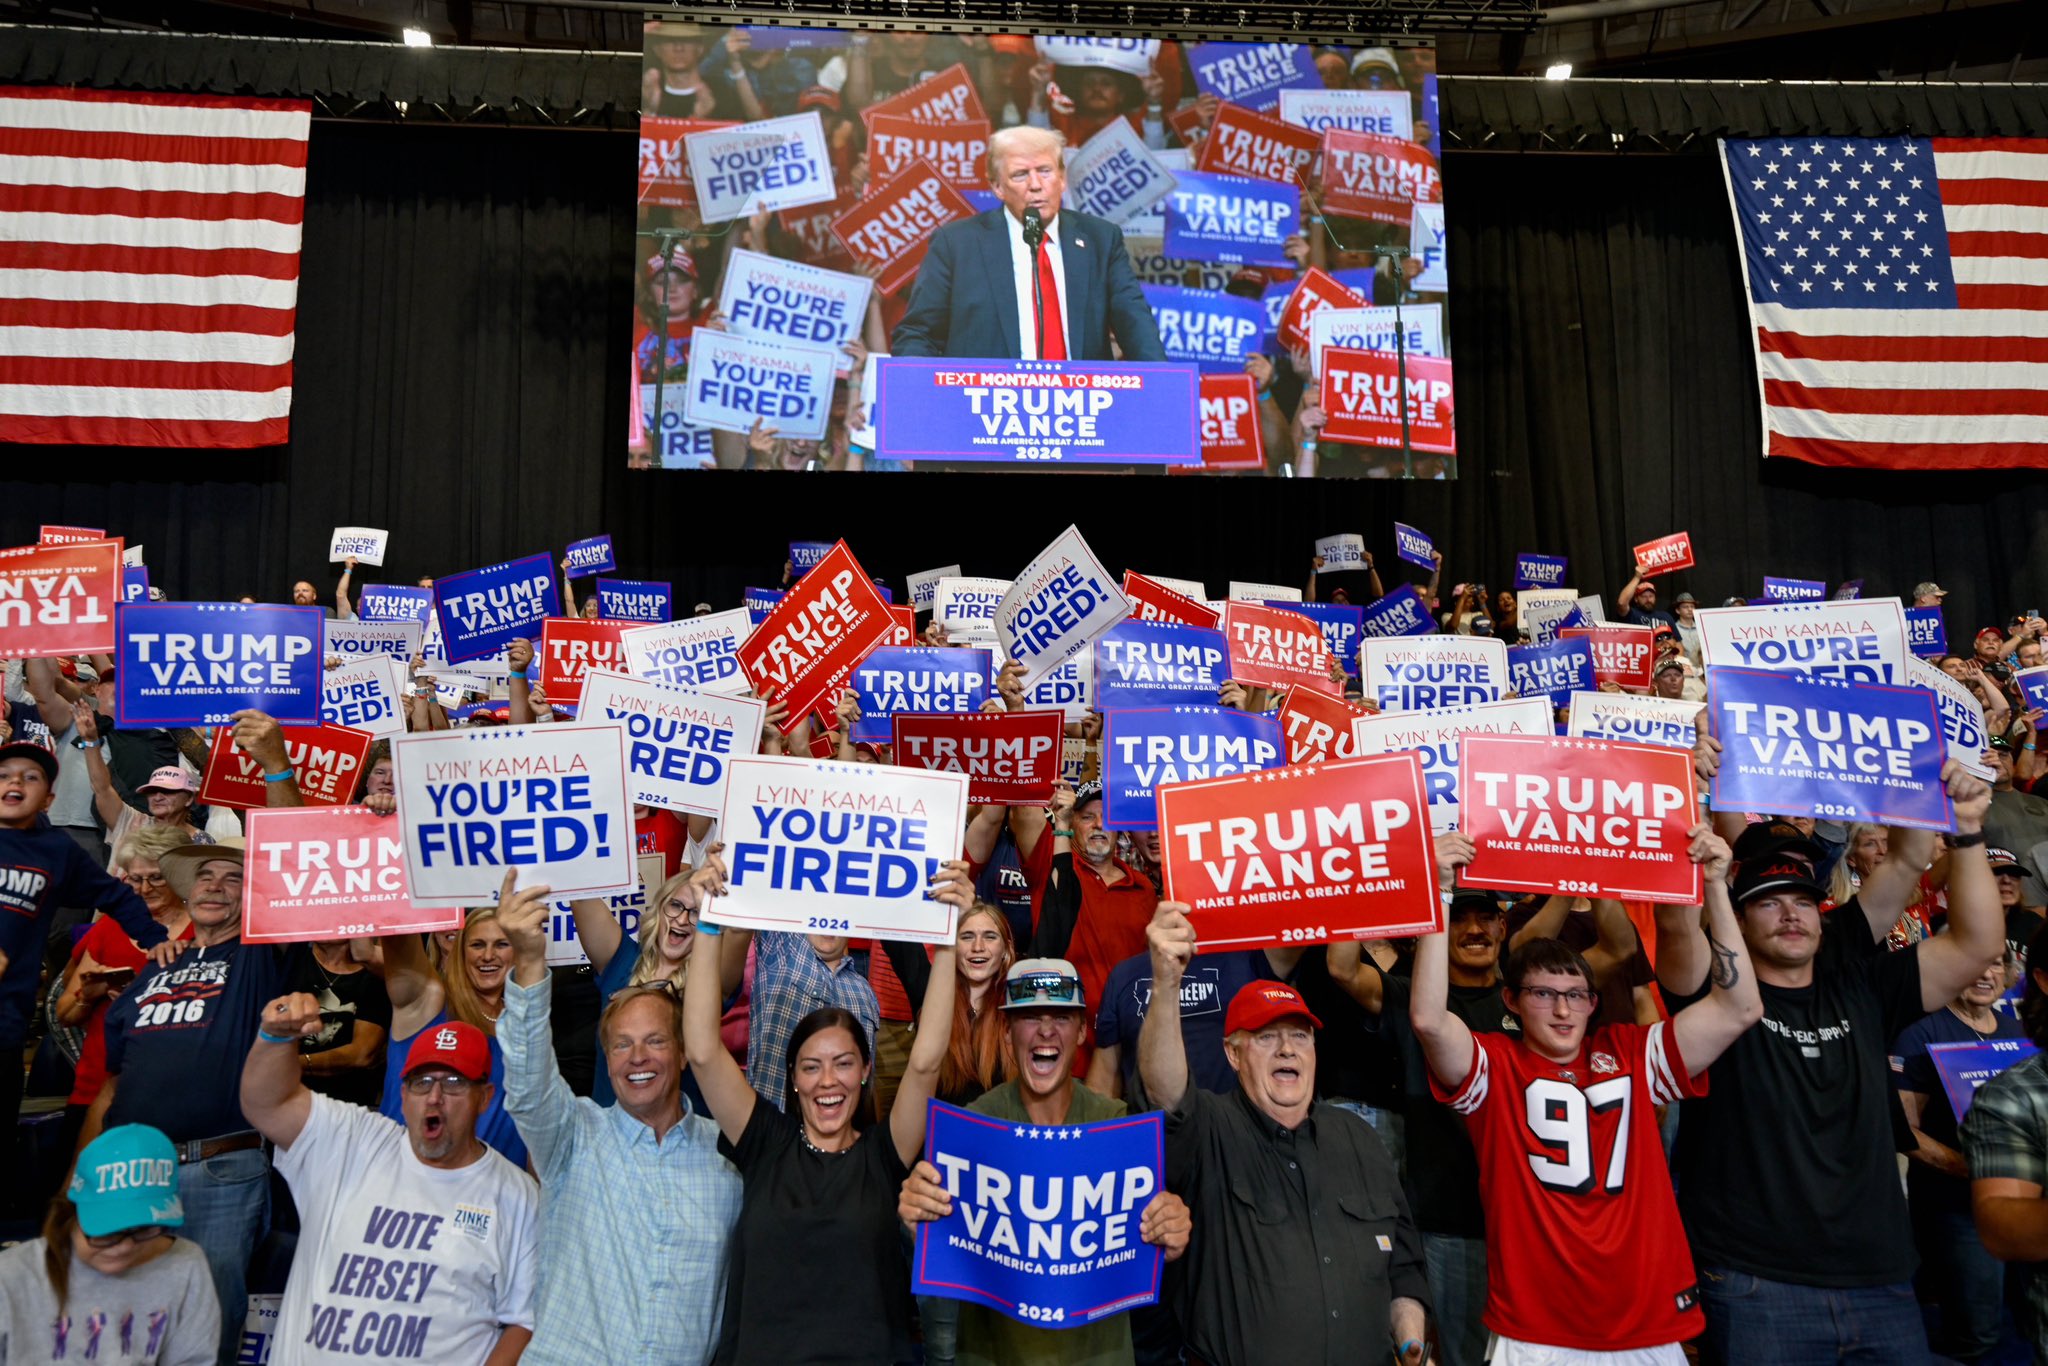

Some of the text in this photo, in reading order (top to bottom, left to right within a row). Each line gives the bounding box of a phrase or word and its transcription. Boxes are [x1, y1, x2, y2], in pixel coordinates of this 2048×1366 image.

[1199, 43, 1299, 85] TRUMP
[711, 142, 806, 174] YOU'RE
[874, 133, 985, 161] TRUMP
[1217, 123, 1311, 168] TRUMP
[1075, 148, 1136, 199] YOU'RE
[1223, 145, 1297, 184] VANCE
[1334, 149, 1440, 186] TRUMP
[707, 160, 818, 200] FIRED!
[1342, 172, 1431, 201] VANCE
[848, 178, 940, 253] TRUMP
[1173, 192, 1291, 221] TRUMP
[870, 200, 948, 260] VANCE
[1186, 214, 1279, 237] VANCE
[746, 281, 846, 319] YOU'RE
[729, 299, 849, 345] FIRED!
[711, 359, 811, 393] YOU'RE
[936, 372, 1141, 388] TEXT MONTANA TO 88022
[1329, 369, 1451, 402] TRUMP
[699, 379, 818, 420] FIRED!
[964, 388, 1113, 416] TRUMP
[981, 414, 1096, 437] VANCE
[1015, 447, 1062, 459] 2024
[335, 544, 379, 557] FIRED!
[339, 537, 377, 547] YOU'RE
[567, 543, 610, 561] TRUMP
[1398, 532, 1433, 550] TRUMP
[1639, 540, 1687, 561] TRUMP
[1519, 561, 1564, 574] TRUMP
[1524, 570, 1558, 580] VANCE
[365, 595, 427, 609] TRUMP
[443, 576, 550, 617] TRUMP
[601, 591, 667, 606] TRUMP
[1003, 556, 1072, 625] LYIN' KAMALA
[1006, 564, 1084, 637] YOU'RE
[0, 596, 108, 627] TRU
[369, 606, 418, 618] VANCE
[461, 597, 544, 632] VANCE
[607, 603, 660, 617] VANCE
[751, 569, 854, 679] TRUMP
[1009, 578, 1109, 666] FIRED!
[331, 631, 407, 640] LYIN' KAMALA
[458, 623, 510, 641] MAKE AMERICA
[645, 626, 734, 651] LYIN' KAMALA
[769, 600, 860, 685] VANCE
[1233, 622, 1328, 654] TRUMP
[1730, 620, 1876, 640] LYIN' KAMALA
[129, 633, 312, 663] TRUMP
[331, 639, 406, 653] YOU'RE
[645, 636, 736, 668] YOU'RE
[775, 610, 870, 701] MAKE AMERICA GREAT AGAIN!
[1065, 639, 1087, 657] 2024
[1102, 640, 1223, 668] TRUMP
[1243, 643, 1325, 671] VANCE
[1385, 651, 1488, 664] LYIN' KAMALA
[1730, 634, 1880, 666] YOU'RE
[150, 662, 292, 686] VANCE
[825, 665, 849, 688] 2024
[1117, 663, 1213, 685] VANCE
[1236, 657, 1306, 674] MAKE AMERICA GREAT
[1384, 664, 1490, 684] YOU'RE
[141, 687, 171, 696] MAKE
[174, 687, 223, 695] AMERICA
[263, 687, 301, 695] AGAIN!
[859, 669, 984, 694] TRUMP
[1133, 683, 1167, 691] AMERICA
[1509, 672, 1579, 693] VANCE
[1933, 680, 1975, 711] KAMALA
[609, 693, 735, 729] LYIN' KAMALA
[873, 693, 969, 712] VANCE
[1377, 684, 1500, 711] FIRED!
[1594, 704, 1697, 723] LYIN' KAMALA
[1723, 702, 1931, 751] TRUMP
[605, 707, 734, 754] YOU'RE
[1592, 714, 1697, 743] YOU'RE
[903, 735, 1052, 760] TRUMP
[1115, 735, 1277, 766] TRUMP
[1749, 735, 1914, 778] VANCE
[426, 753, 588, 782] LYIN' KAMALA
[1739, 765, 1923, 791] MAKE AMERICA GREAT AGAIN!
[426, 775, 592, 818] YOU'RE
[637, 790, 669, 805] 2024
[755, 784, 927, 817] LYIN' KAMALA
[1474, 771, 1684, 819] TRUMP
[1814, 804, 1857, 817] 2024
[418, 812, 611, 869] FIRED!
[751, 805, 928, 852] YOU'RE
[1174, 798, 1411, 862] TRUMP
[1497, 807, 1663, 849] VANCE
[260, 837, 403, 872] TRUM
[1486, 839, 1674, 862] MAKE AMERICA GREAT AGAIN!
[281, 869, 401, 896] VANC
[730, 841, 939, 901] FIRED!
[1203, 843, 1391, 894] VANCE
[270, 893, 398, 908] MAKE AMERICA GREAT
[1196, 879, 1406, 910] MAKE AMERICA GREAT AGAIN!
[1557, 879, 1599, 894] 2024
[338, 923, 375, 935] 2024
[808, 917, 850, 930] 2024
[1281, 926, 1327, 942] 2024
[1263, 991, 1295, 1000] TRUMP
[135, 999, 205, 1028] 2016
[1525, 1075, 1632, 1196] 97
[96, 1158, 173, 1193] TRUMP
[936, 1151, 1154, 1222] TRUMP
[362, 1206, 444, 1250] VOTE
[455, 1209, 490, 1229] ZINKE
[960, 1202, 1128, 1260] VANCE
[949, 1235, 1136, 1276] MAKE AMERICA GREAT AGAIN!
[330, 1253, 438, 1303] JERSEY
[1018, 1302, 1064, 1321] 2024
[305, 1304, 432, 1358] JOE.COM
